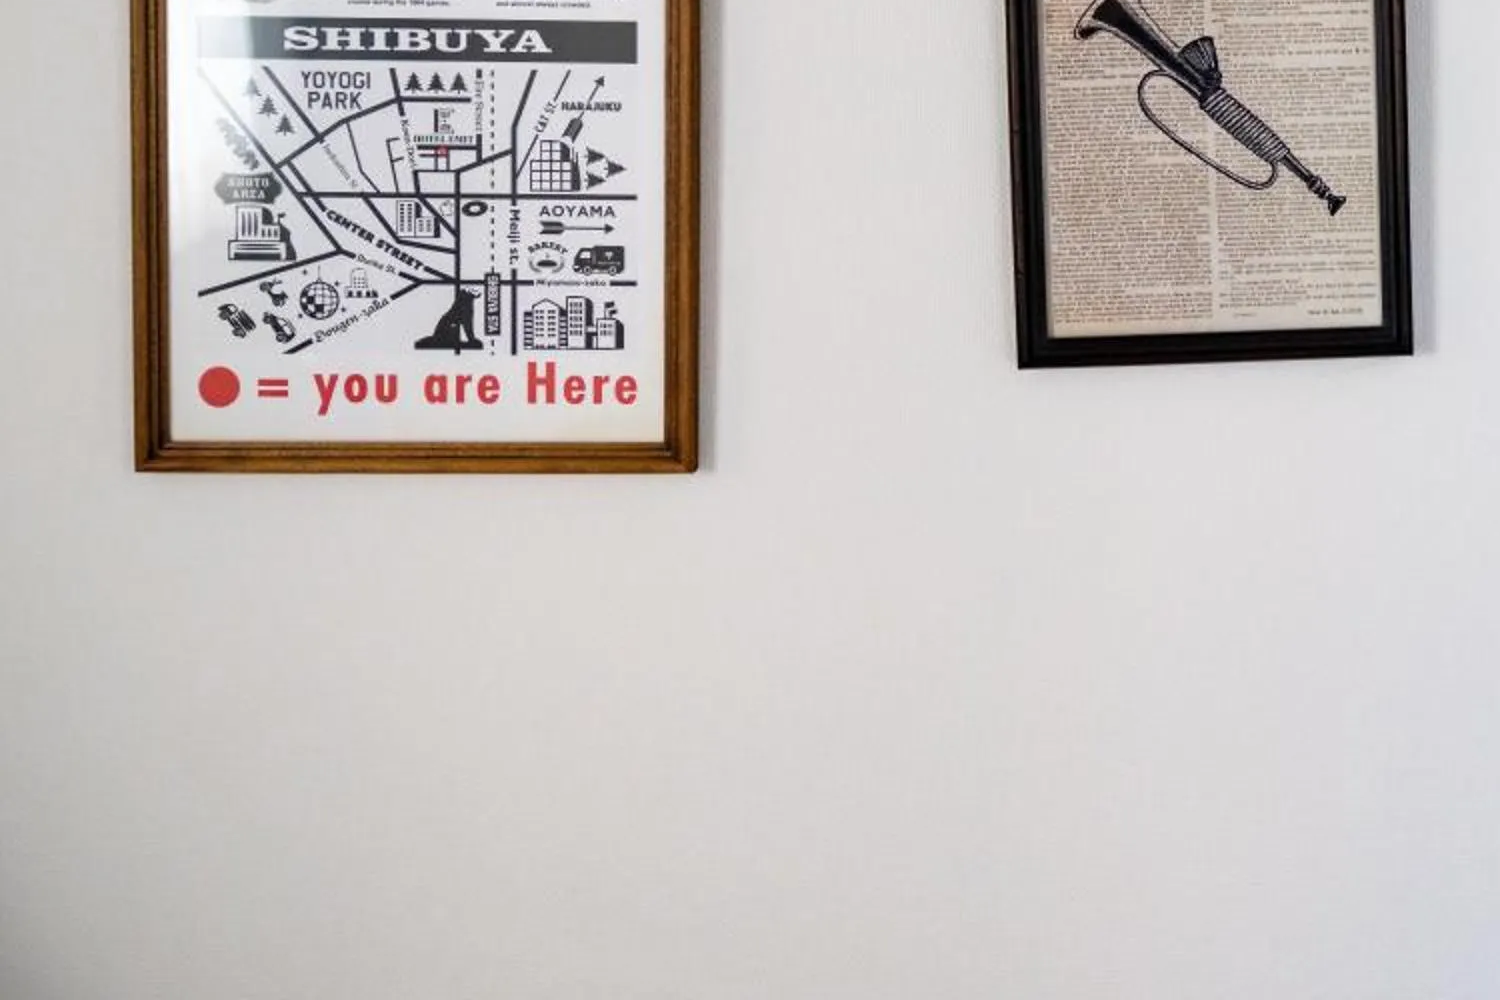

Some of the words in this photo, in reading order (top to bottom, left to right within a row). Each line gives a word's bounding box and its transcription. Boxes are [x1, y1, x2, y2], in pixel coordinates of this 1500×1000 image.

[283, 26, 553, 55] SHIBUYA
[301, 71, 371, 89] YOYOGI
[307, 91, 362, 110] PARK
[539, 205, 616, 217] AOYAMA
[327, 210, 376, 243] CENTER
[375, 239, 425, 270] STREET
[314, 371, 398, 415] you
[424, 371, 499, 405] are
[526, 361, 637, 405] Here
